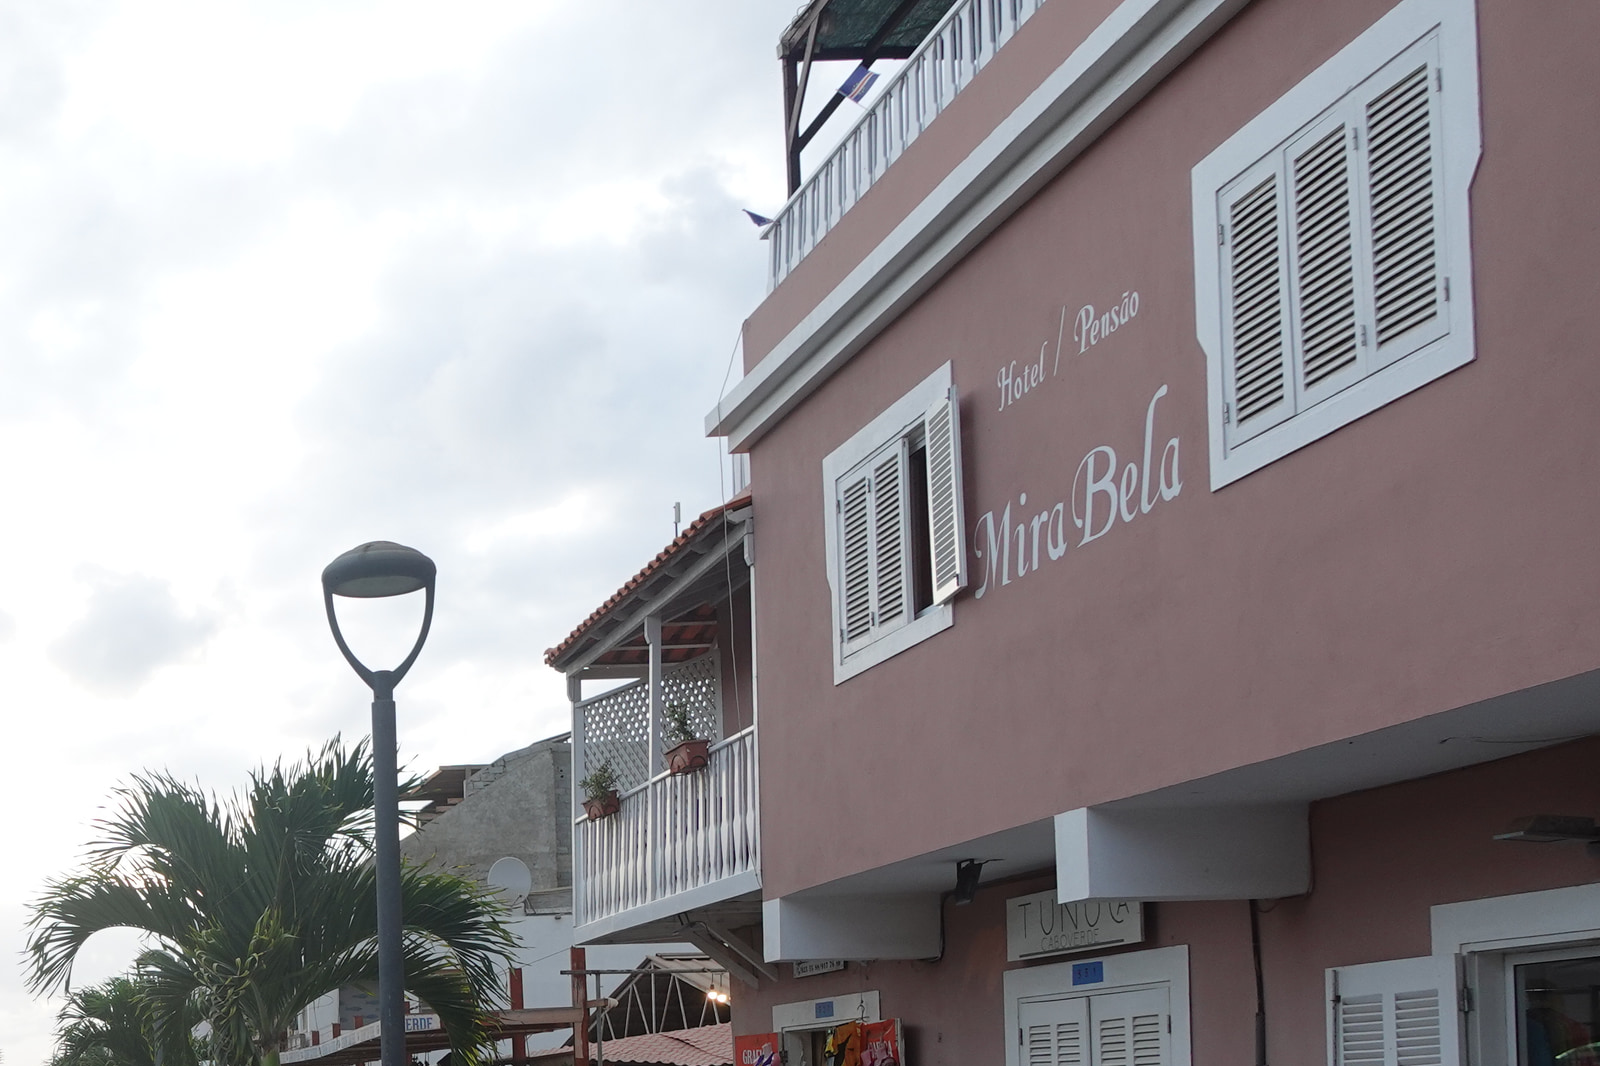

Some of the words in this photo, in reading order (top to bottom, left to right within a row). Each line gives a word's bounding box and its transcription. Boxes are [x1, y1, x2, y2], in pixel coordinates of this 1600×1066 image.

[996, 341, 1048, 412] Hotel
[1074, 289, 1140, 355] Pensão
[974, 493, 1067, 600] Mira
[1071, 384, 1183, 548] Bela
